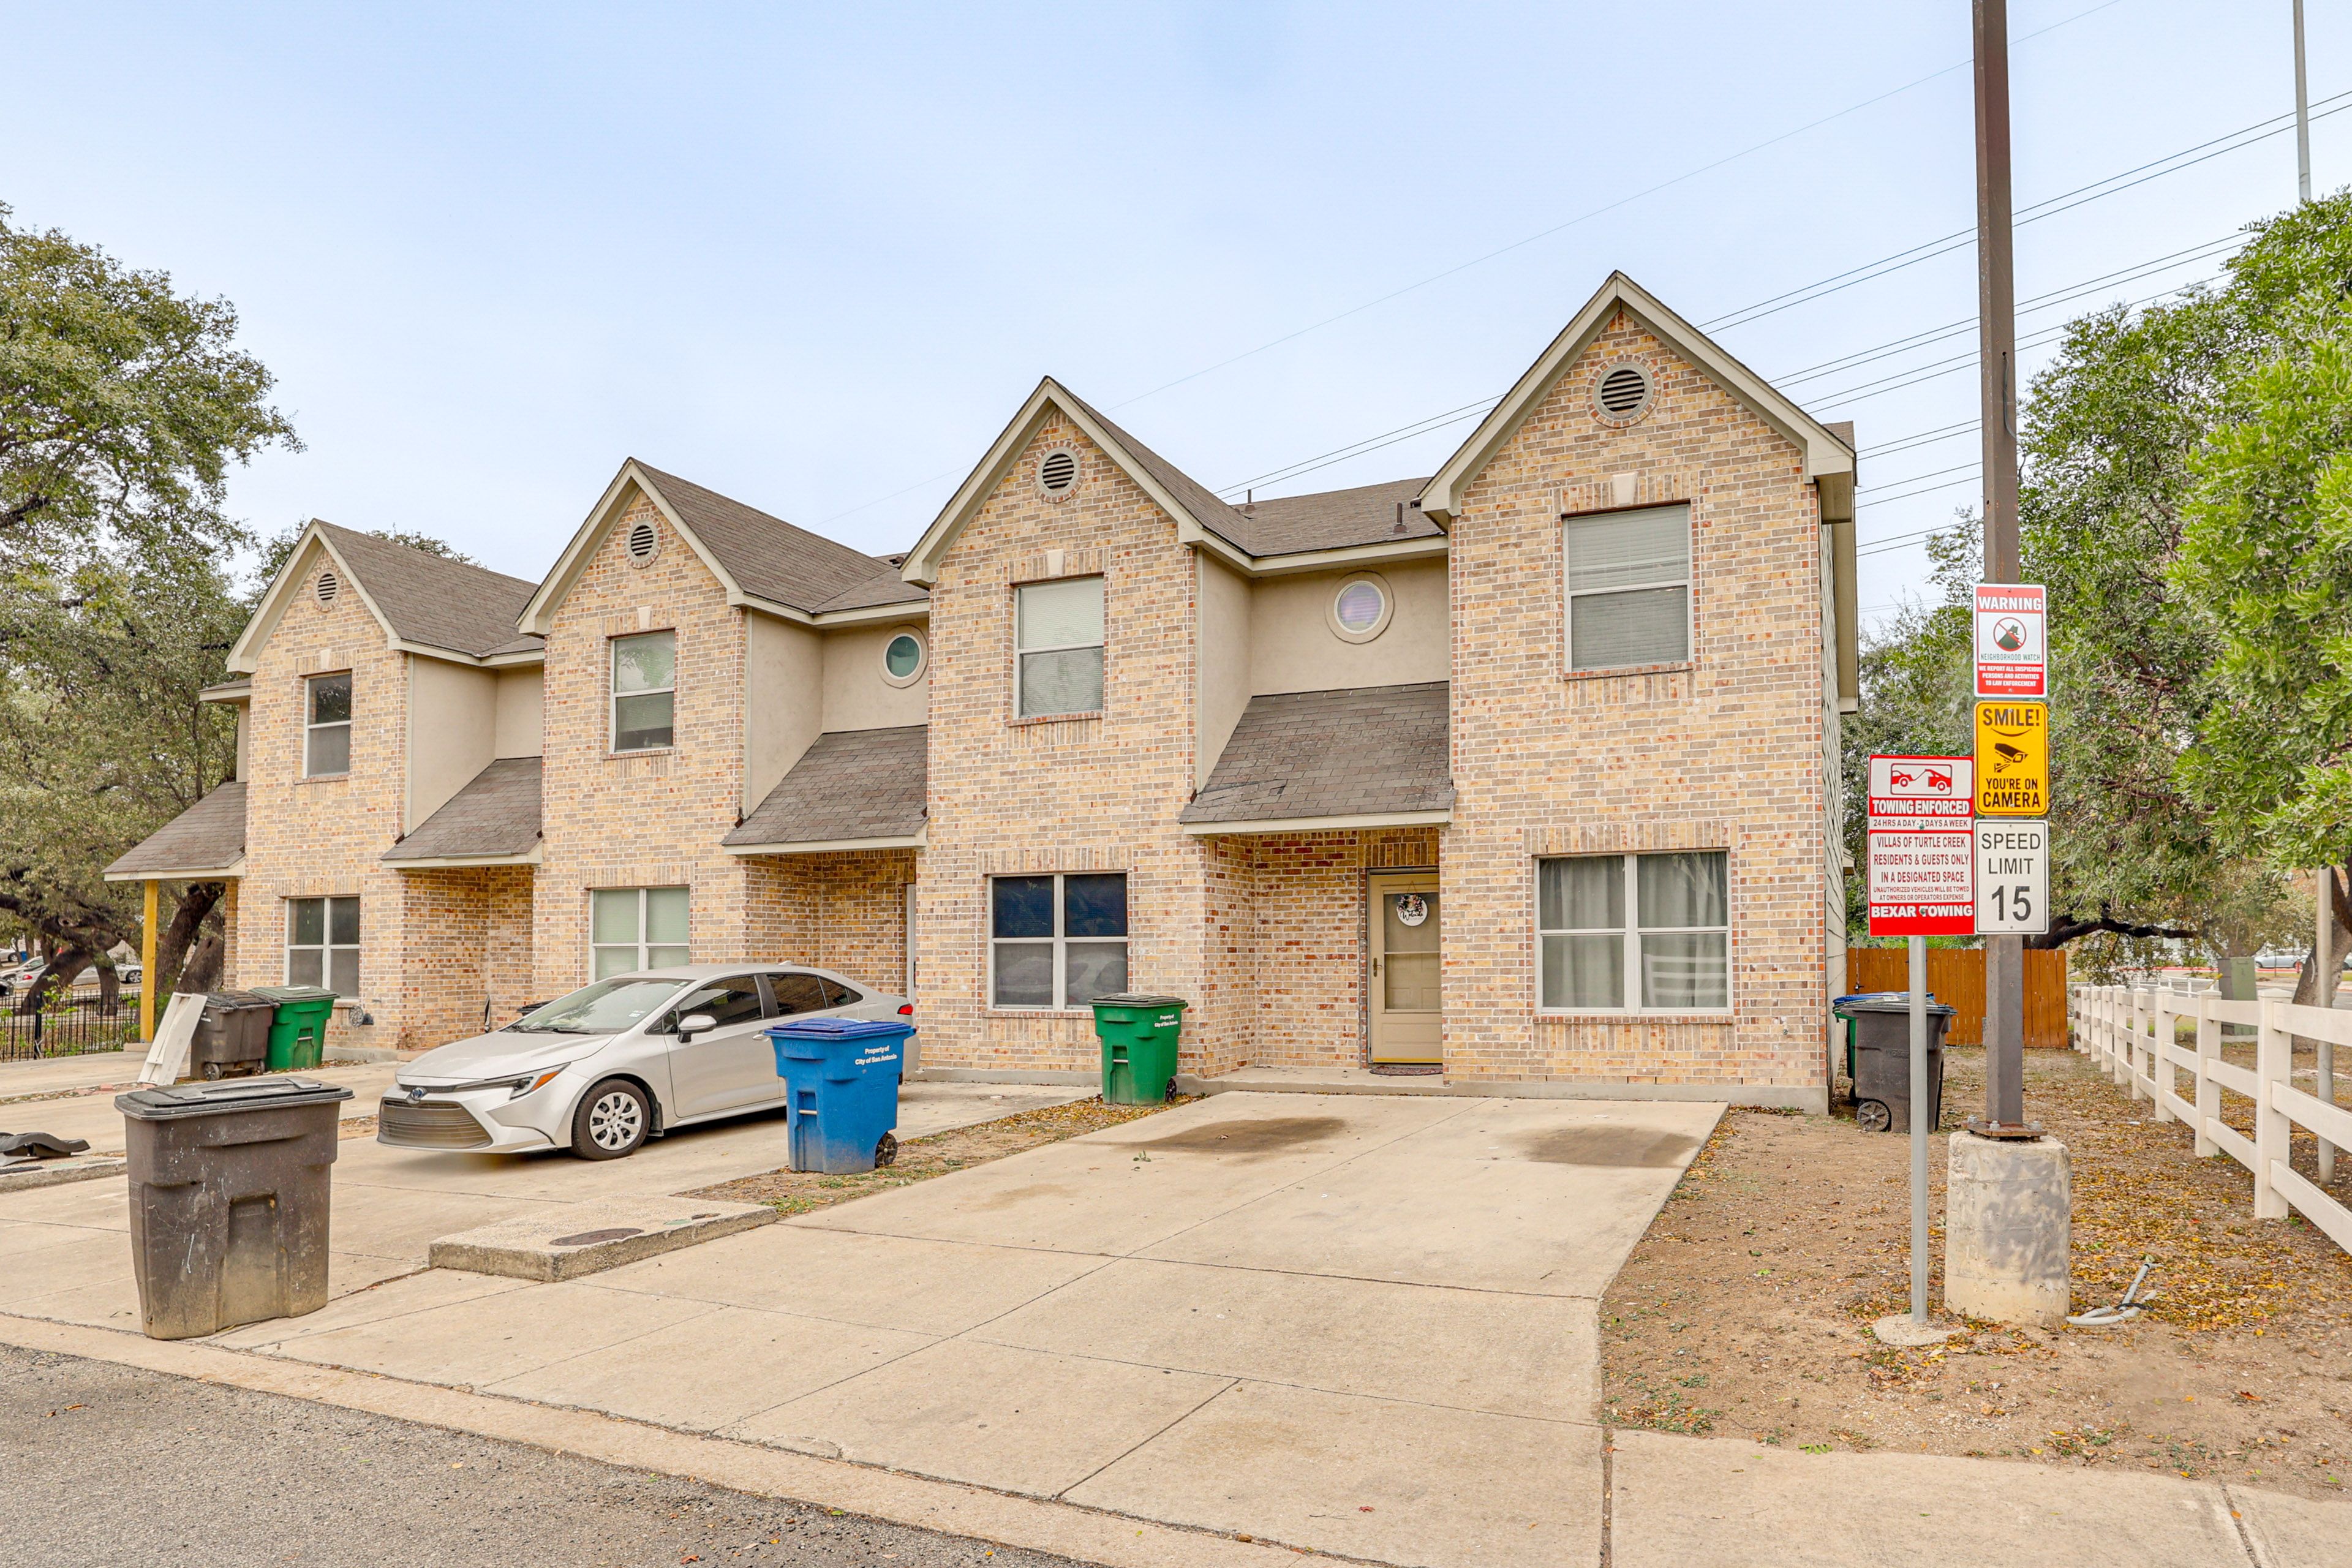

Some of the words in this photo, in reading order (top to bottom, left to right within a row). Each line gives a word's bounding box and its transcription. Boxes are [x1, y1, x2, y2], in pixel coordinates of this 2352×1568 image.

[1978, 597, 2042, 611] WARNING
[1983, 708, 2040, 726] SMILE!
[1986, 778, 2021, 790] YOU'RE
[2025, 778, 2038, 790] ON
[1872, 799, 1914, 814] TOWING
[1915, 800, 1970, 815] ENFORCED
[1983, 792, 2040, 808] CAMERA
[1877, 837, 1901, 848] VILLAS
[1903, 837, 1912, 848] OF
[1915, 837, 1940, 848] TURTLE
[1943, 837, 1966, 848] CREEK
[1981, 833, 2041, 850] SPEED
[1874, 854, 1912, 865] RESIDENTS
[1915, 854, 1920, 865] &
[1922, 854, 1949, 865] GUESTS
[1951, 854, 1969, 865] ONLY
[1988, 858, 2034, 874] LIMIT
[1881, 872, 1888, 883] IN
[1891, 872, 1895, 883] A
[1898, 872, 1940, 883] DESIGNATED
[1942, 872, 1964, 883] SPACE
[1991, 885, 2031, 921] 15
[1871, 905, 1917, 918] BEXAR
[1919, 905, 1973, 917] TOWING
